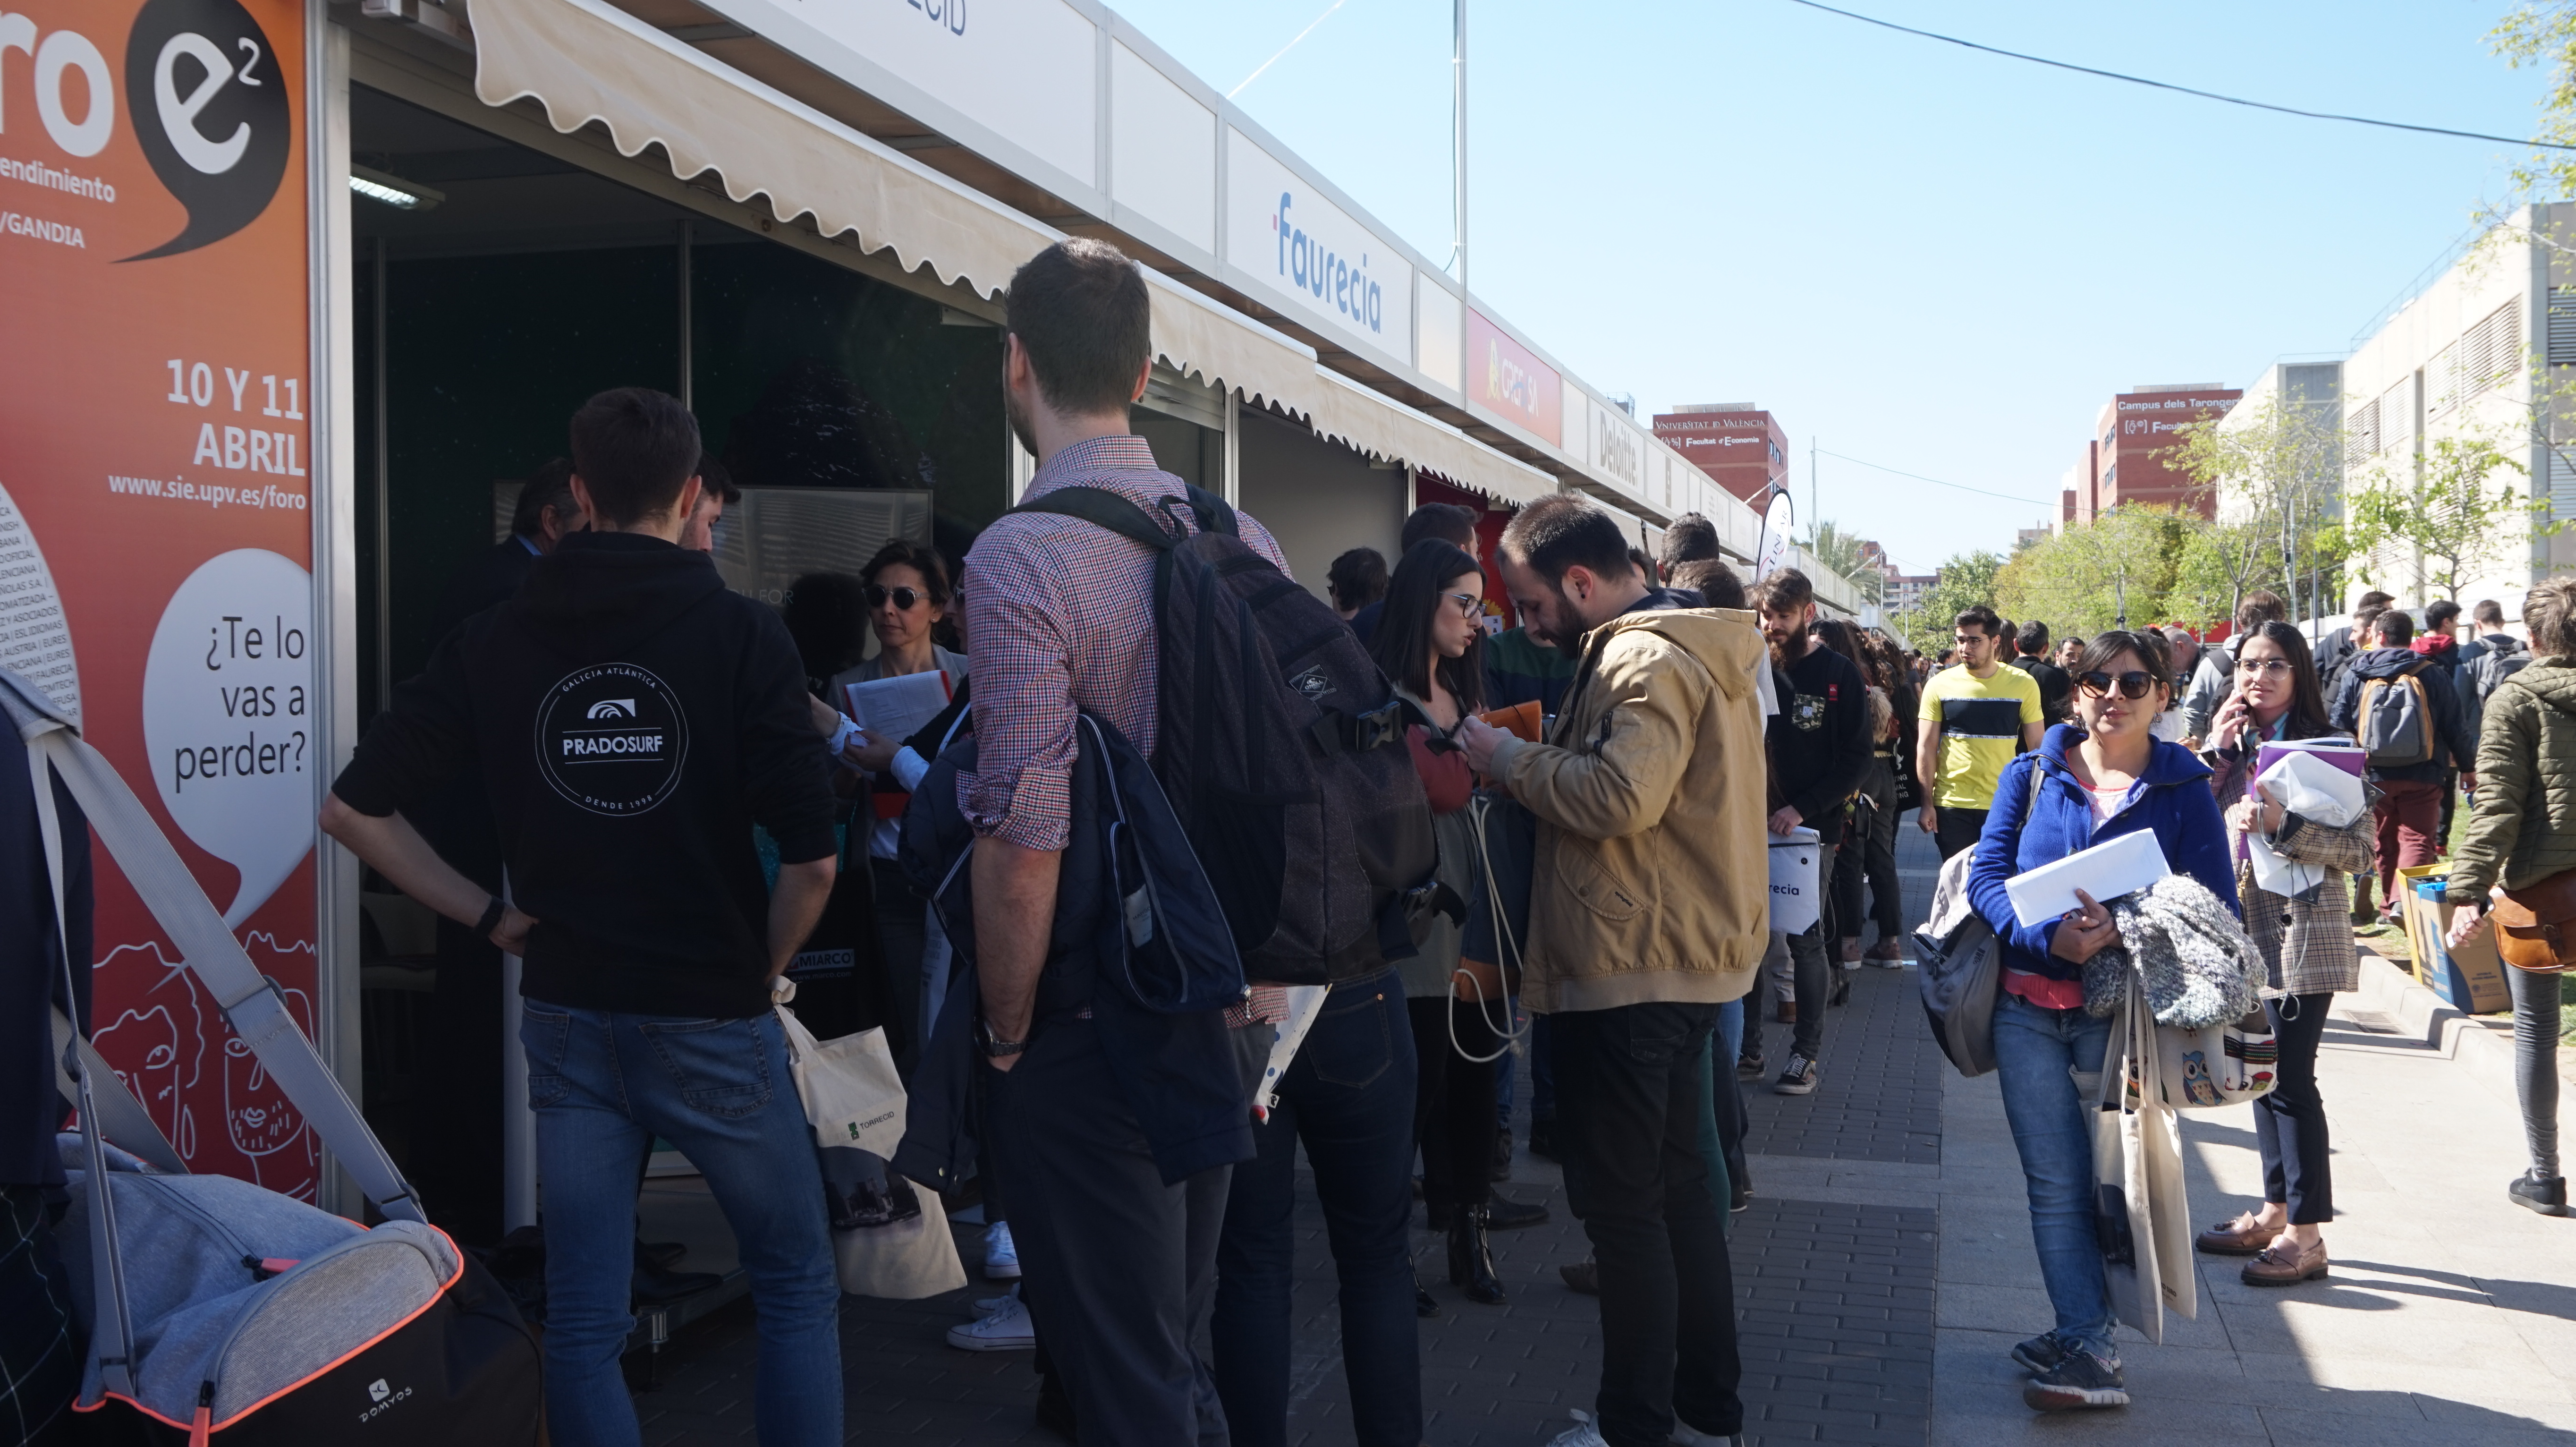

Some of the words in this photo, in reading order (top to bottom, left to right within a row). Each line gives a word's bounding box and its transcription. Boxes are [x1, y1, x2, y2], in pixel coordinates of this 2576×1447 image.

[1279, 192, 1381, 334] faurecia
[168, 359, 212, 407] 10
[224, 367, 249, 412] Y
[262, 375, 304, 420] 11
[2118, 401, 2161, 411] Campus
[2164, 400, 2186, 409] dels
[2189, 398, 2239, 409] Taronger
[193, 423, 305, 477] ABRIL
[1686, 437, 1716, 447] Facultat
[108, 475, 306, 510] www.sie.upv.es/foro
[5, 549, 36, 562] OFICIAL
[0, 564, 36, 579] ENCIANA
[759, 588, 793, 604] FOR
[13, 605, 58, 623] ASOCIADOS
[28, 620, 62, 636] IDIOMAS
[4, 641, 37, 656] AUSTRIA
[42, 634, 67, 647] EURES
[206, 616, 263, 671] ¿Te
[276, 615, 305, 659] lo
[46, 649, 70, 662] EURES
[36, 664, 73, 680] FAURECIA
[562, 669, 602, 692] GALICIA
[607, 667, 656, 689] ATLÁNTICA
[220, 685, 276, 717] vas
[288, 684, 305, 716] a
[563, 735, 663, 756] PRADOSURF
[176, 730, 306, 793] perder?
[585, 796, 623, 809] DENDE
[630, 795, 652, 809] 1998
[799, 952, 851, 968] MIARCO
[791, 971, 852, 981] www.miarco.com
[859, 1111, 895, 1130] TORRECID
[359, 1386, 412, 1422] DOMYOS
